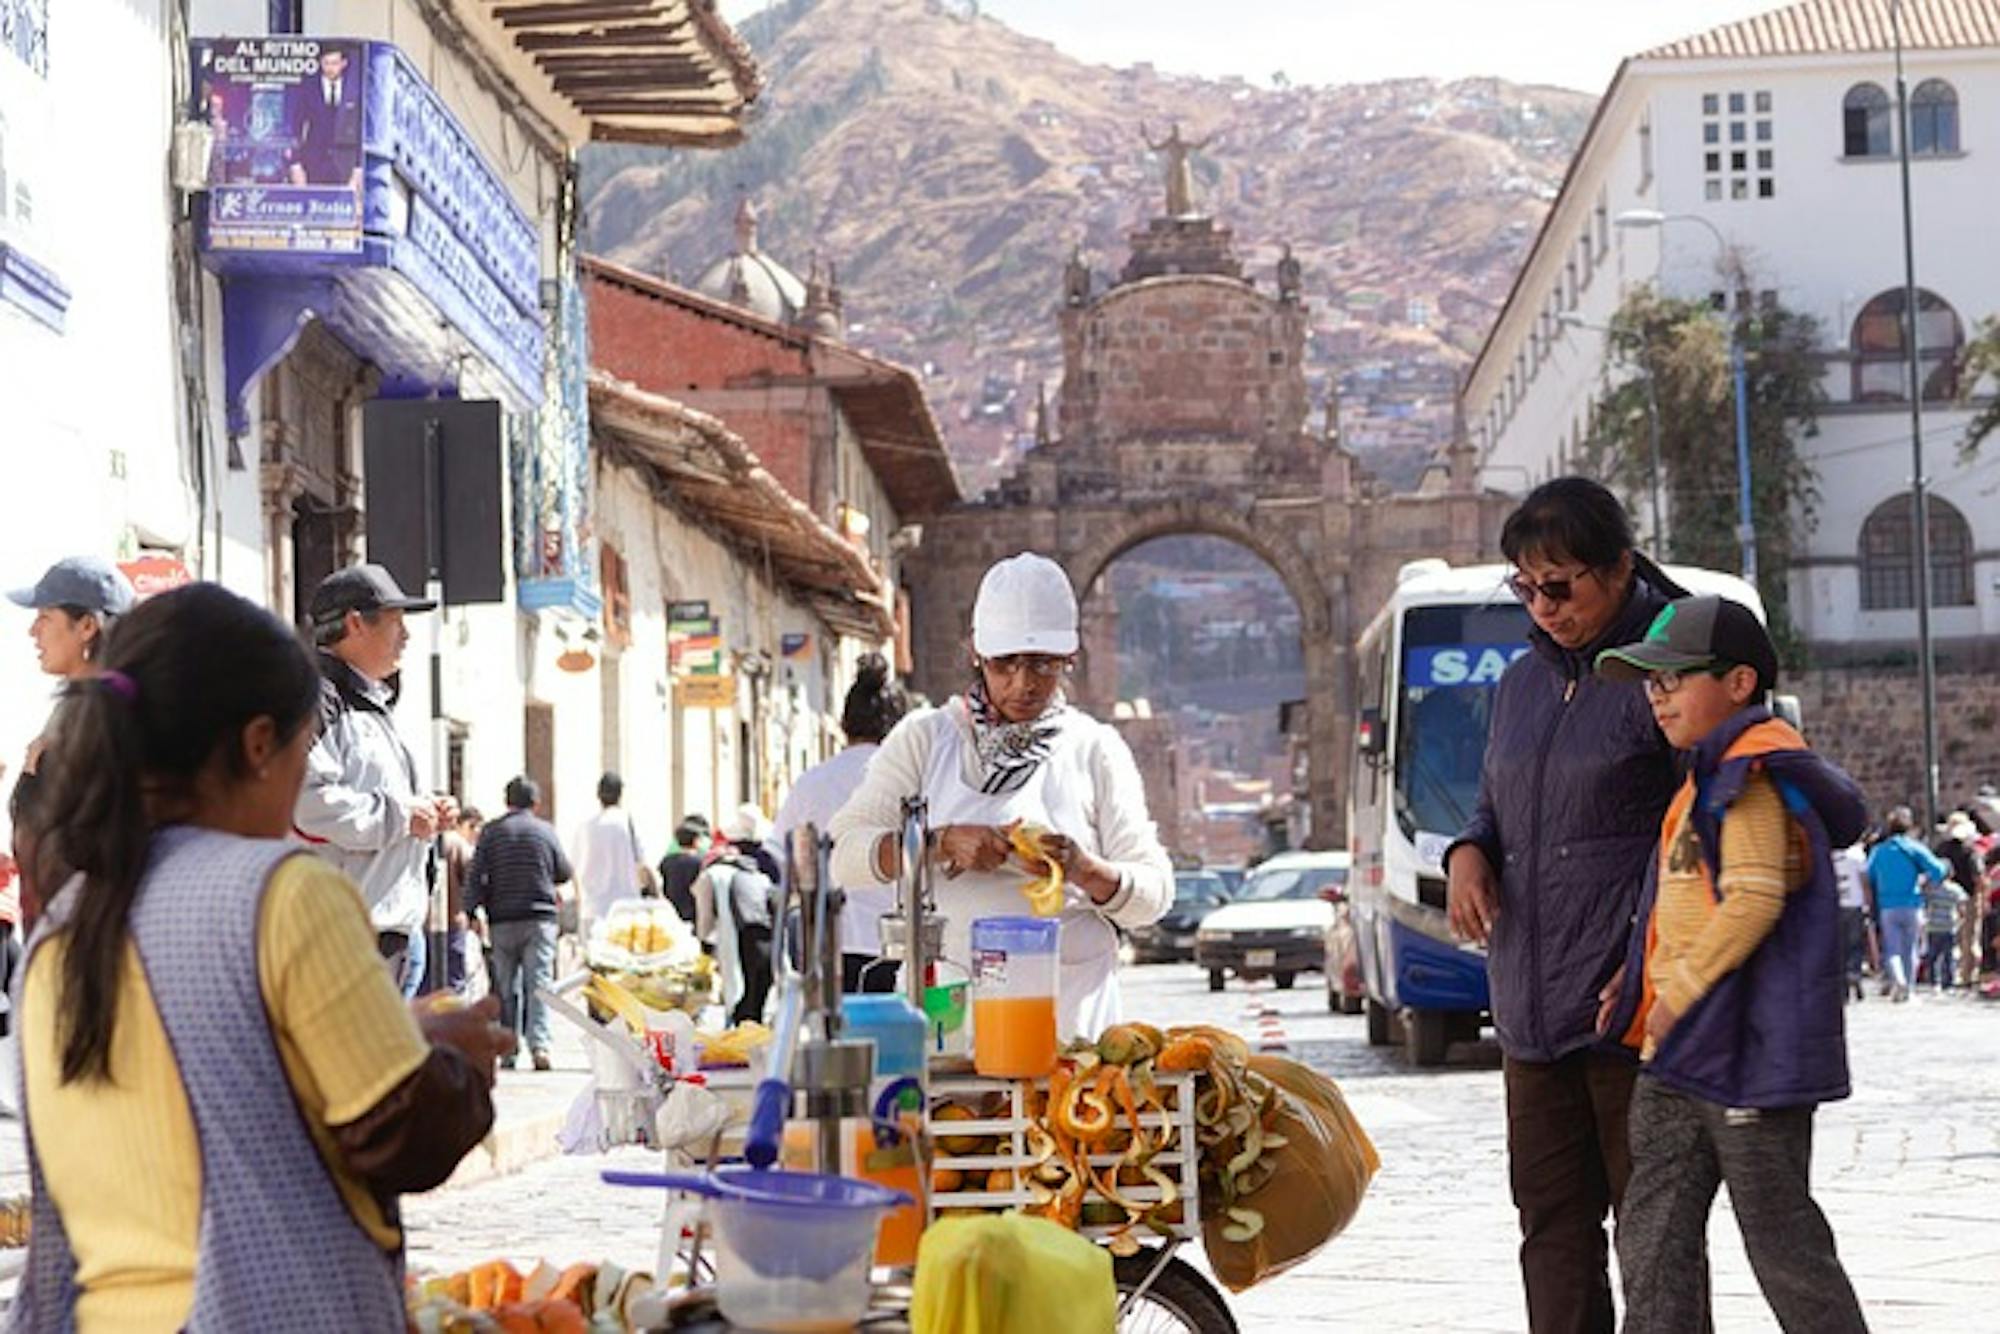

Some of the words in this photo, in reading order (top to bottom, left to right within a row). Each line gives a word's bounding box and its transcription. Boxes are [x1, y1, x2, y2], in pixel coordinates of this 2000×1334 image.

[236, 41, 260, 56] AL
[263, 41, 320, 57] RITMO
[214, 57, 250, 72] DEL
[252, 57, 320, 74] MUNDO
[1430, 648, 1530, 684] SA
